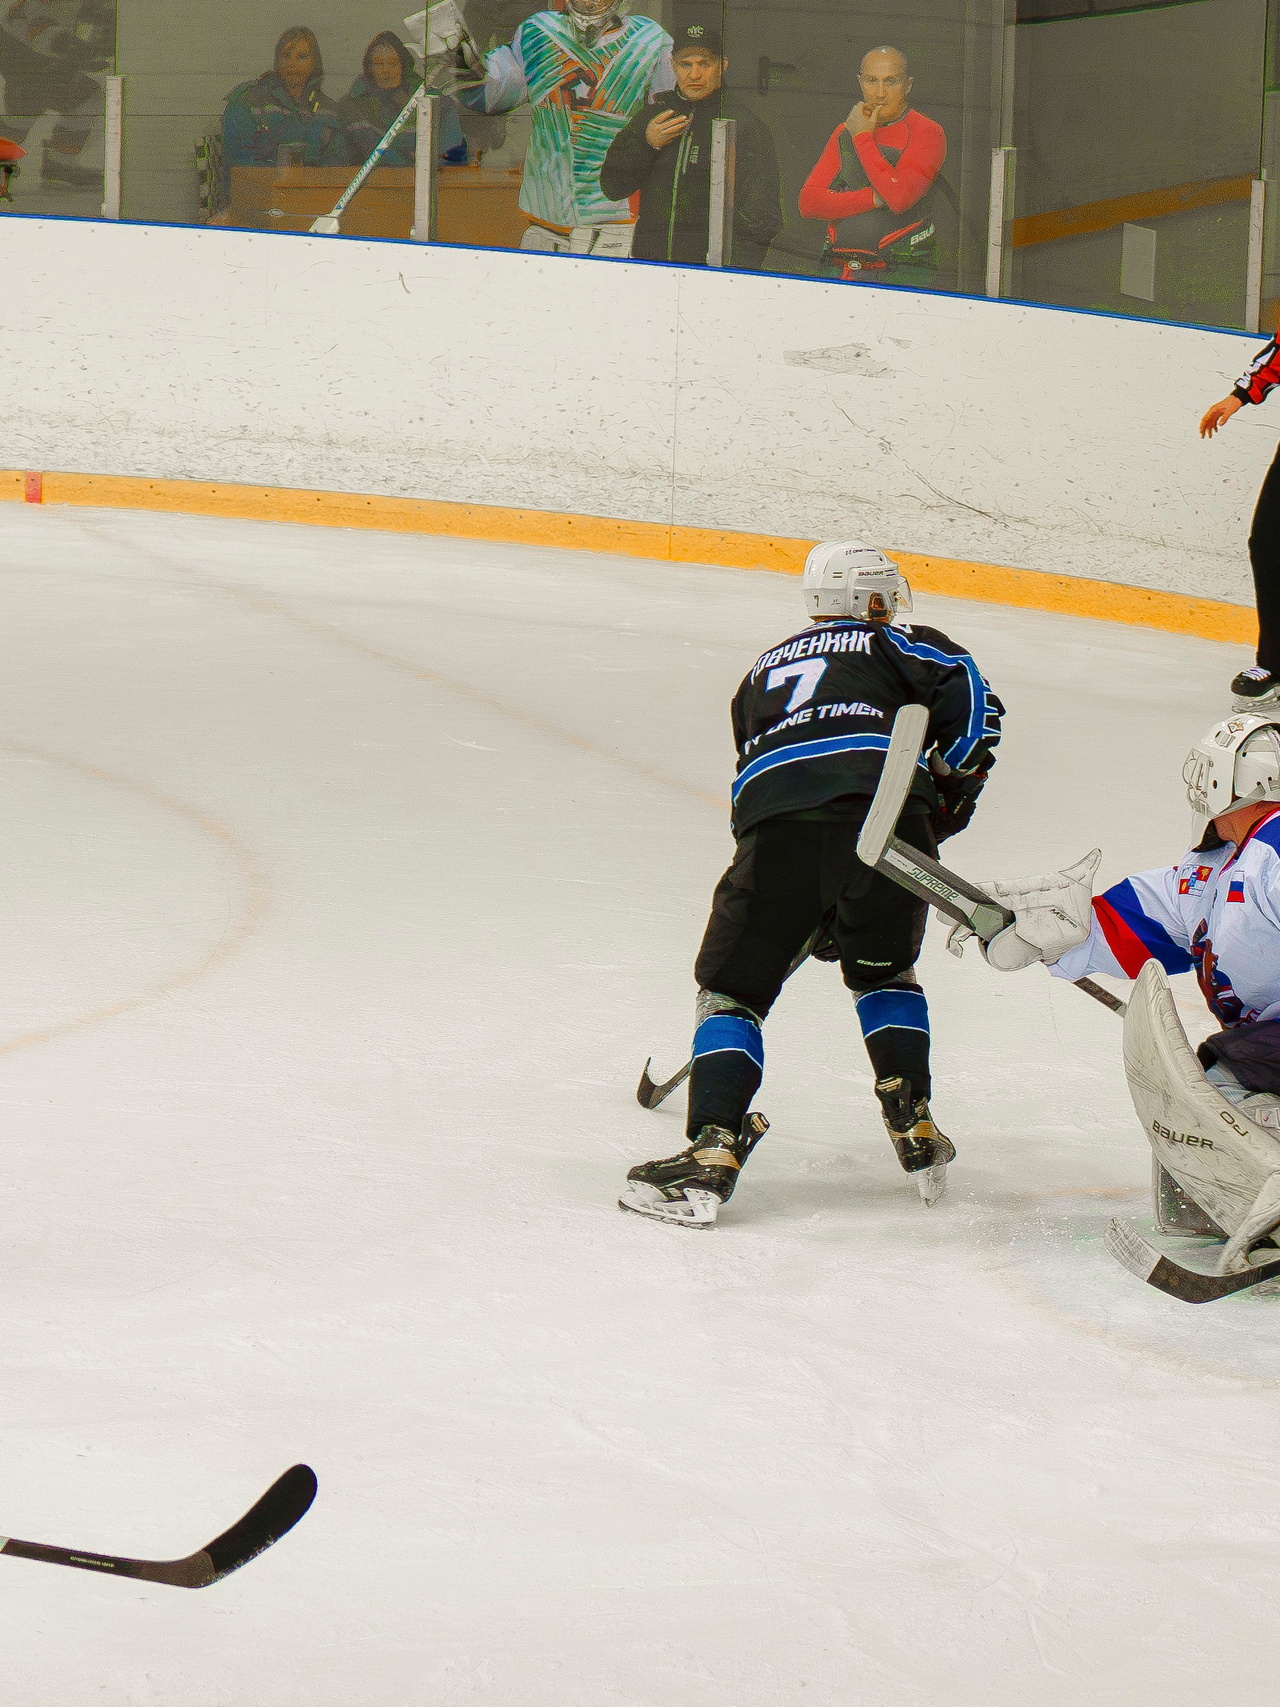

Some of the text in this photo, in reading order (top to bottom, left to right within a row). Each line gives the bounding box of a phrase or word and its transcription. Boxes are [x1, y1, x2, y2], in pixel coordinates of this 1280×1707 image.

[687, 25, 704, 37] NYC
[765, 655, 830, 714] 7
[816, 702, 884, 719] TIMER
[1152, 1119, 1215, 1151] BAUER
